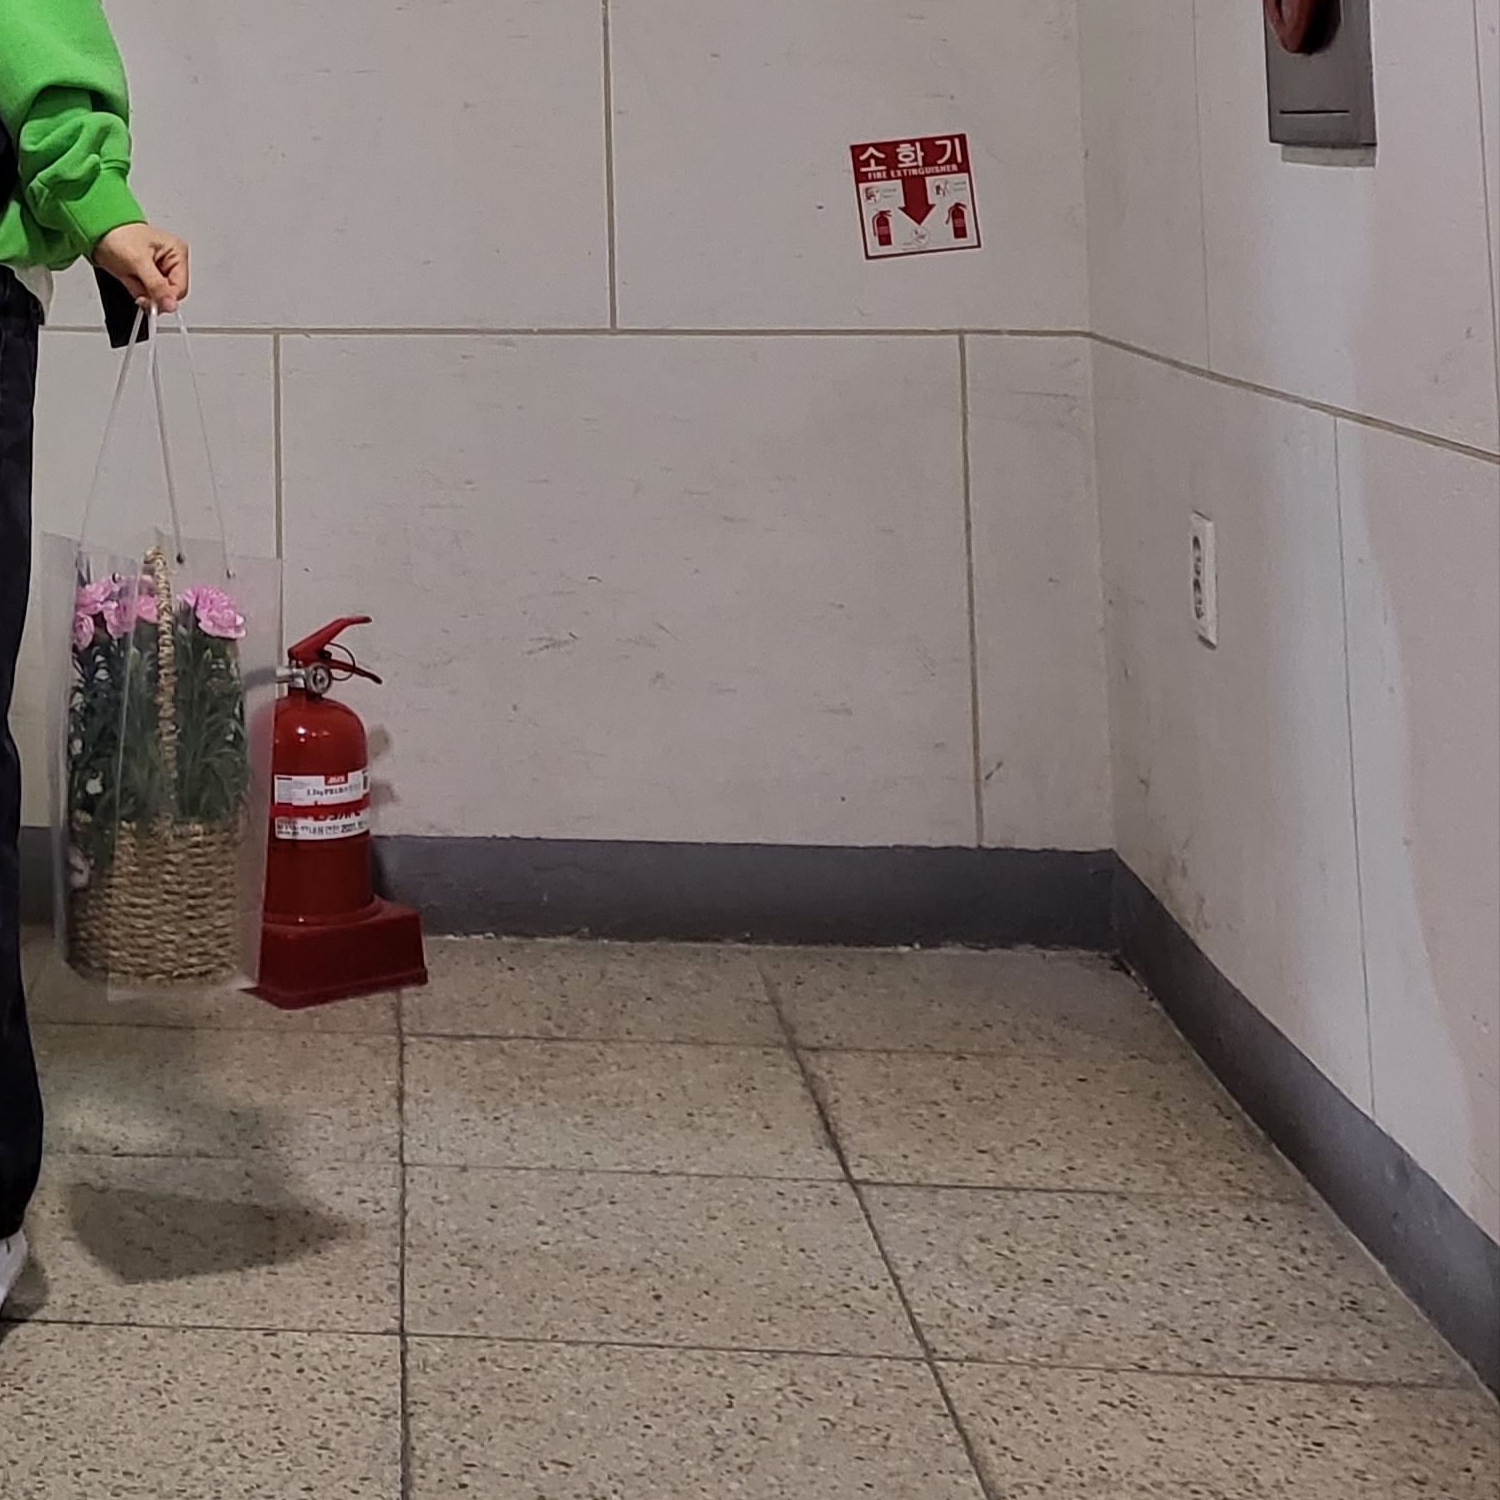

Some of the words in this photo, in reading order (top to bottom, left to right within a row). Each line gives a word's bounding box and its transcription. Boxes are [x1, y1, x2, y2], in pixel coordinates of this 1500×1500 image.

[859, 138, 962, 172] 소화기
[867, 171, 888, 180] FIRE
[890, 164, 958, 178] EXTINGUISHER
